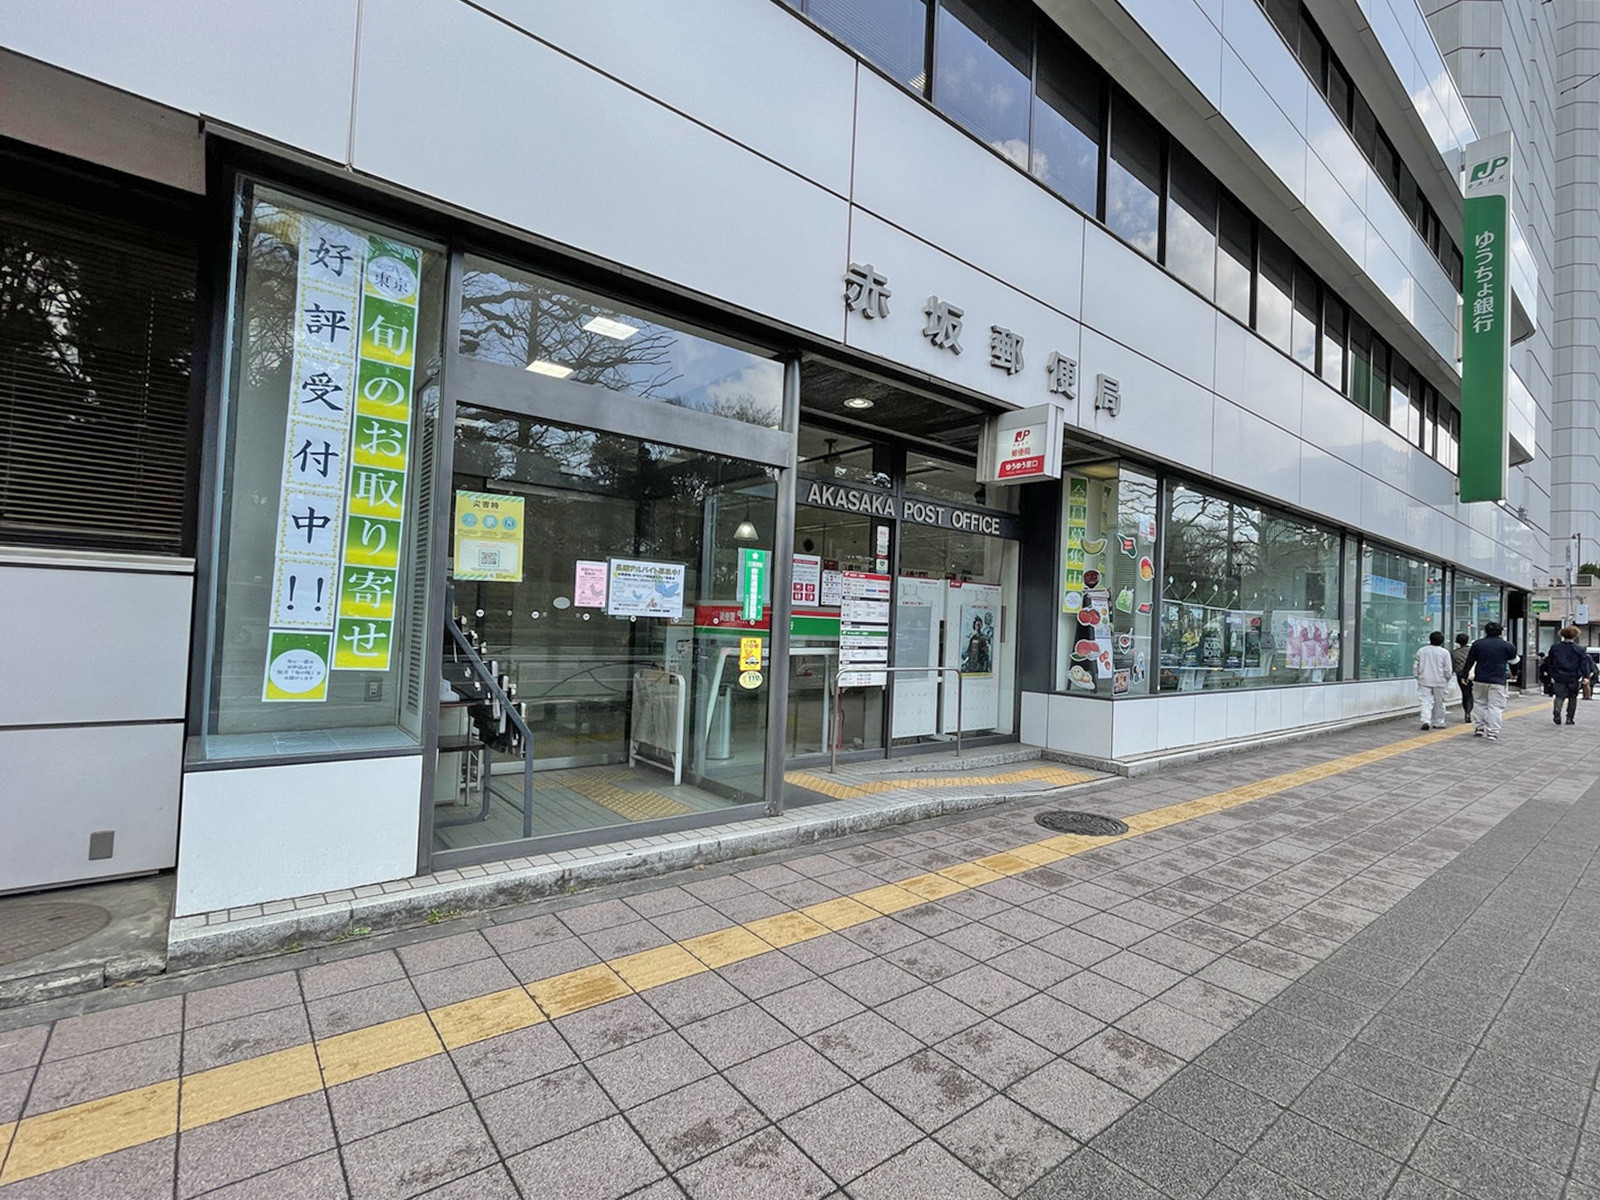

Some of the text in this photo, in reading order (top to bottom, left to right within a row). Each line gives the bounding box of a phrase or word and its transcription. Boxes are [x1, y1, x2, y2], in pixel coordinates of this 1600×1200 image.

[1468, 174, 1505, 190] BANK
[1472, 230, 1494, 334] ゆうちょ銀行
[844, 262, 1122, 417] 赤坂郵便局
[342, 314, 409, 658] 旬のお取り寄せ
[1005, 460, 1038, 471] ゆうゆう窓口
[807, 483, 1000, 535] AKASAKA POST OFFICE
